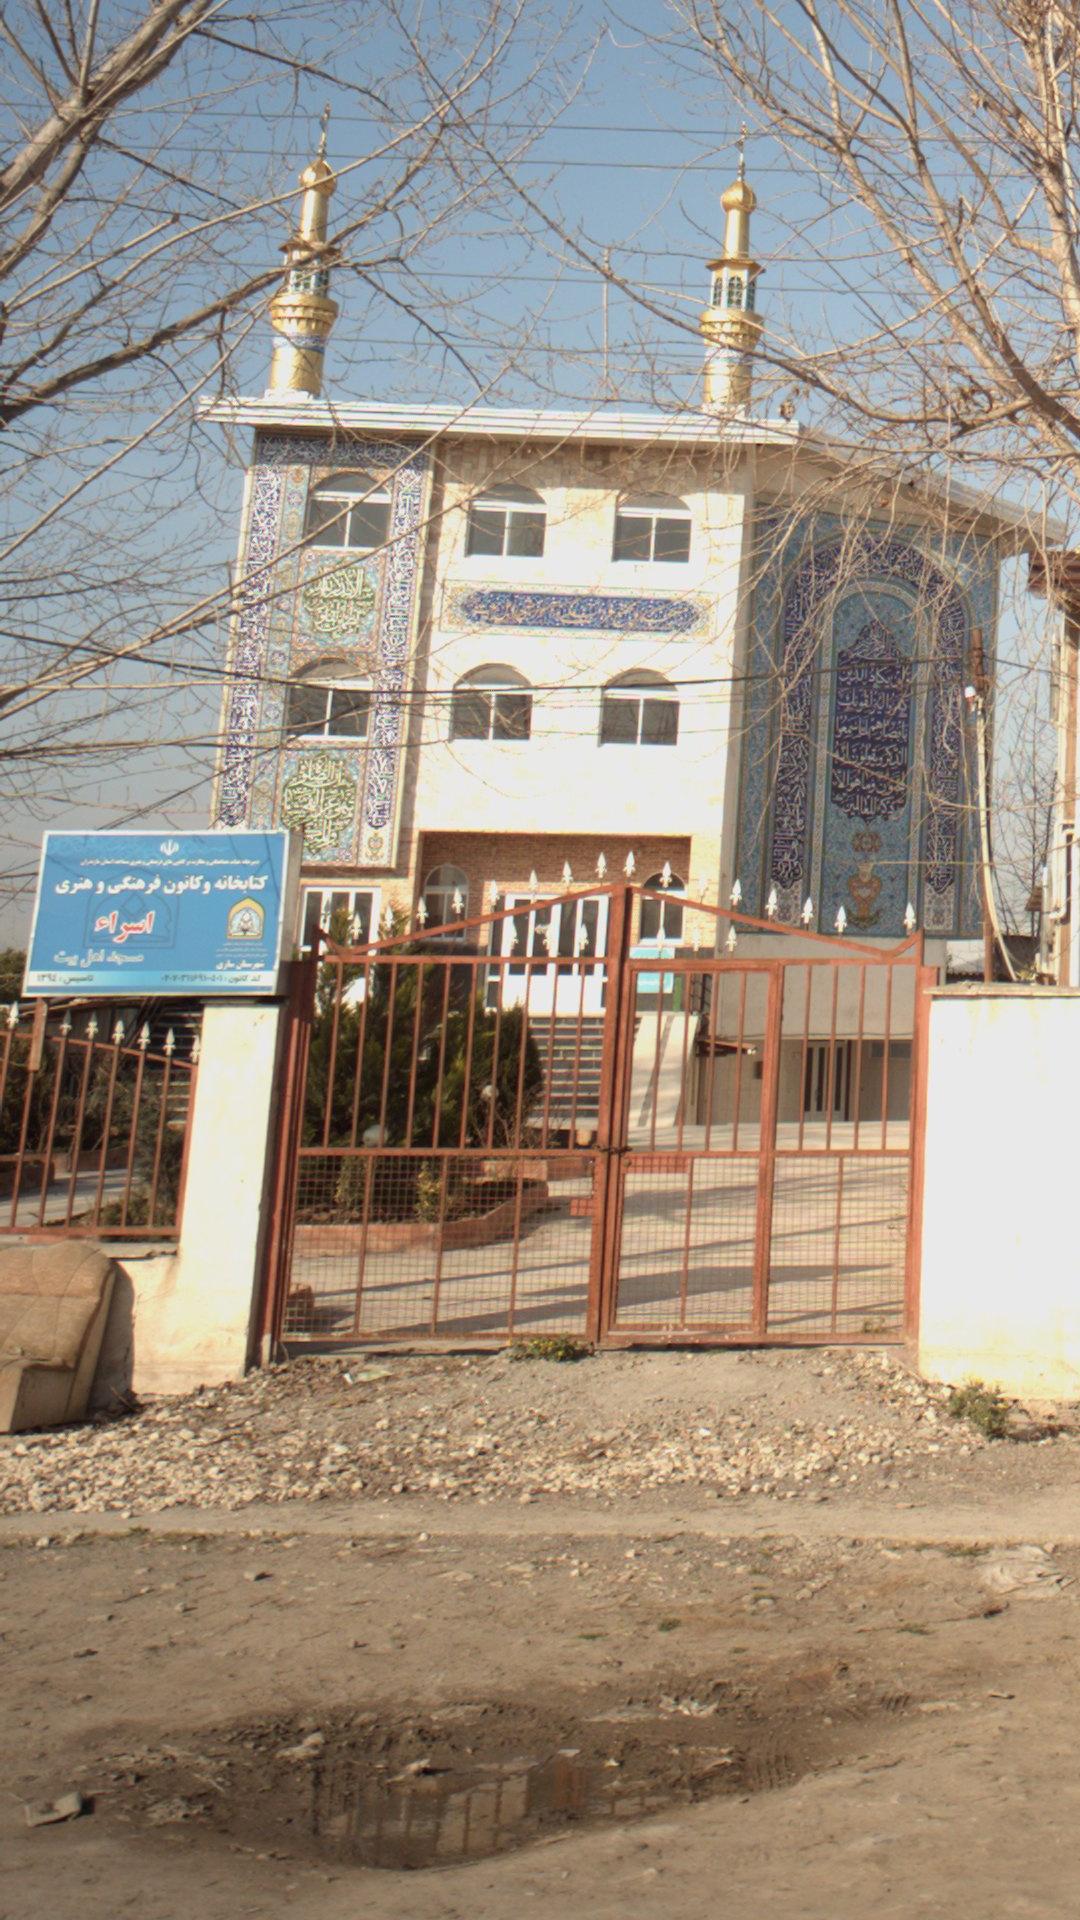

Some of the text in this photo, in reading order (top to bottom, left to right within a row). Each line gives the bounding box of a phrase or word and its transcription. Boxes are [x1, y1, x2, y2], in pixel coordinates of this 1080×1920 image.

[54, 876, 93, 894] هنری
[95, 880, 105, 894] و
[107, 873, 162, 894] فرهنگی
[214, 874, 269, 893] کتابخانه
[94, 910, 156, 943] اسراء
